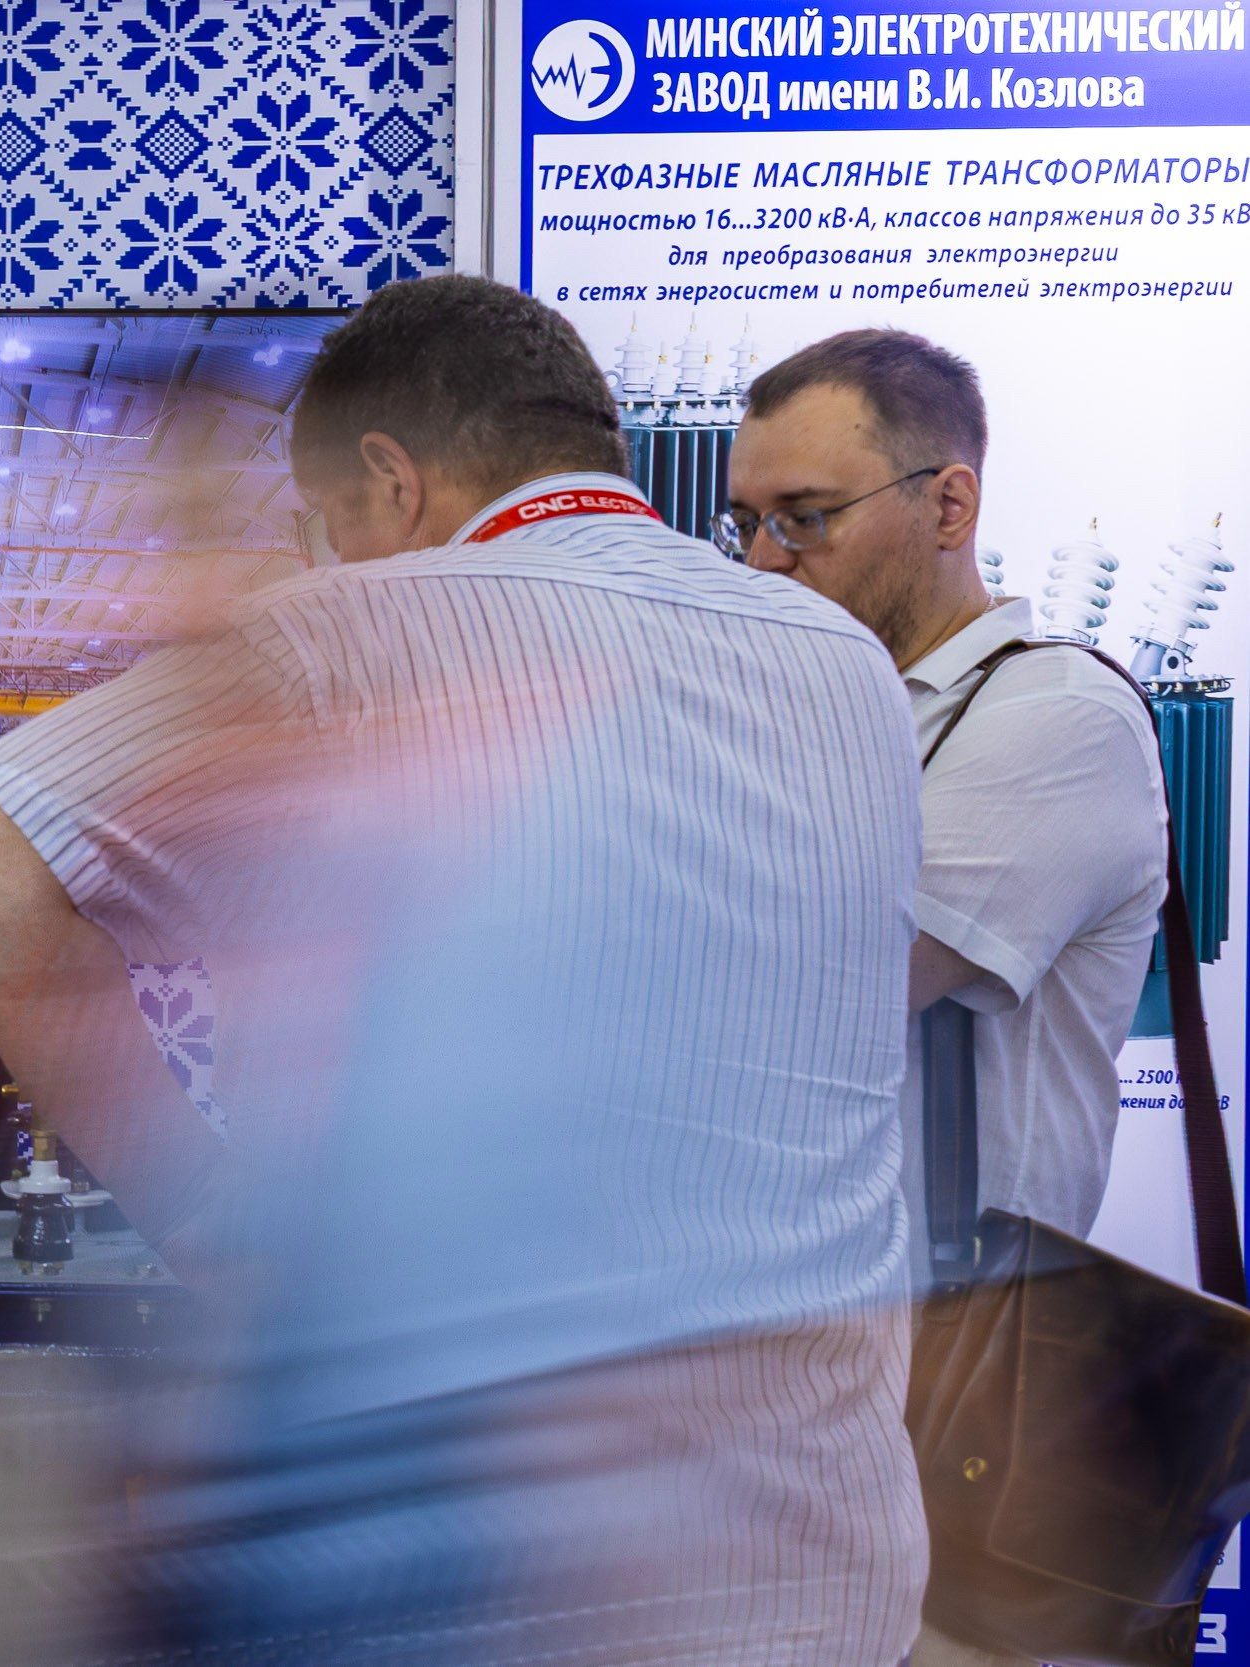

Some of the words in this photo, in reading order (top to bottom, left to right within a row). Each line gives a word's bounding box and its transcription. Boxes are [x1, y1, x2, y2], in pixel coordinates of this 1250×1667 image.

[646, 8, 823, 59] МИНСКИЙ
[831, 1, 1245, 57] ЭЛЕКТРОТЕХНИЧЕСКИЙ
[652, 71, 771, 120] ЗАВОД
[778, 80, 899, 112] имени
[908, 68, 982, 110] В.И.
[990, 67, 1145, 109] Козлова
[538, 162, 741, 191] ТРЕХФАЗНЫЕ
[753, 160, 931, 188] МАСЛЯНЫЕ
[946, 157, 1250, 186] ТРАНСФОРМАТОРЫ
[540, 212, 696, 235] мощностью
[704, 207, 813, 231] 16...3200
[883, 209, 981, 228] классов
[988, 208, 1144, 232] напряжения
[1150, 202, 1180, 226] до
[1187, 203, 1216, 225] 35
[1222, 202, 1250, 225] кВ
[668, 245, 708, 266] для
[722, 244, 912, 270] преобразования
[926, 246, 1119, 268] электроэнергии
[557, 286, 569, 301] в
[578, 285, 647, 301] сетях
[656, 284, 819, 305] энергосистем
[829, 283, 842, 299] и
[852, 277, 1031, 303] потребителей
[1039, 279, 1233, 302] электроэнергии
[518, 494, 578, 521] CNC
[1136, 1069, 1174, 1084] 2500
[1169, 1094, 1186, 1109] до
